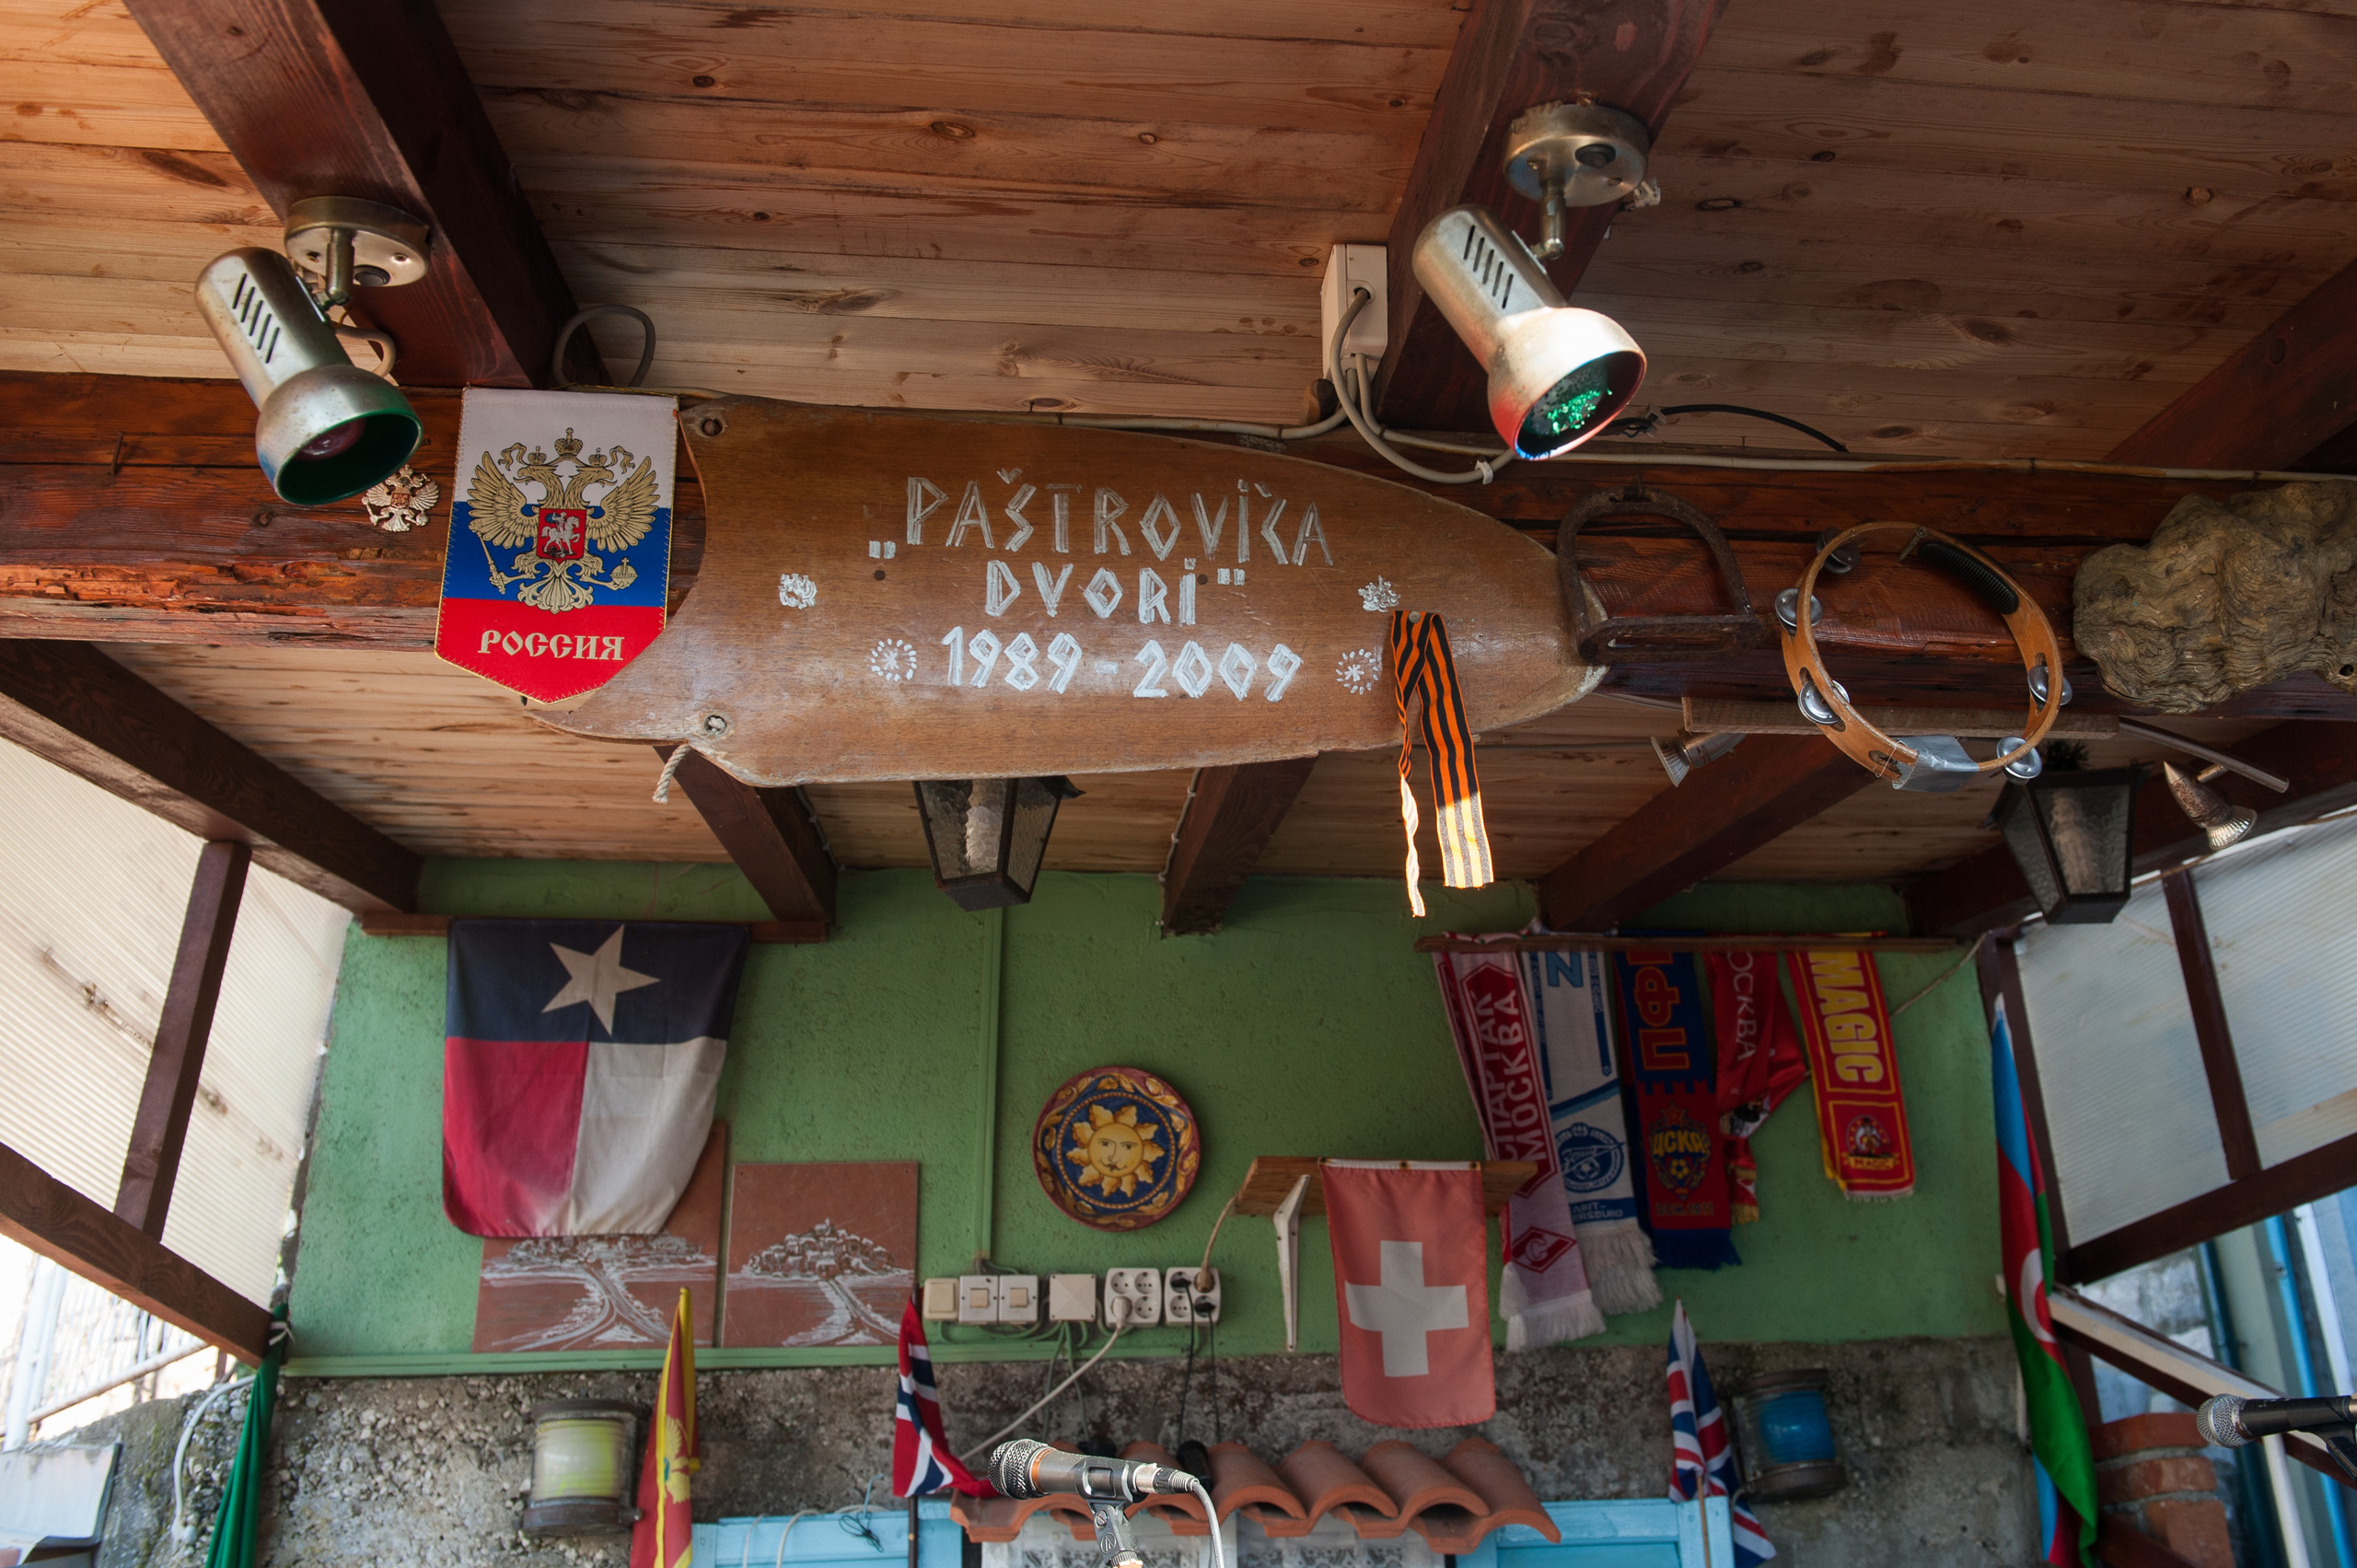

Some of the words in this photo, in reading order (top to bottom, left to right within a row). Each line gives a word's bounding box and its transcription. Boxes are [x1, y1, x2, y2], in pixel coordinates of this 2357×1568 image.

[478, 630, 624, 660] РОССИЯ
[941, 626, 1083, 693] 1989
[1133, 639, 1303, 703] 2009
[1727, 951, 1758, 1061] ОСКВА
[1809, 952, 1884, 1083] MAGIC
[1493, 989, 1547, 1161] МОСКВА
[1653, 1130, 1703, 1157] ЦСКА
